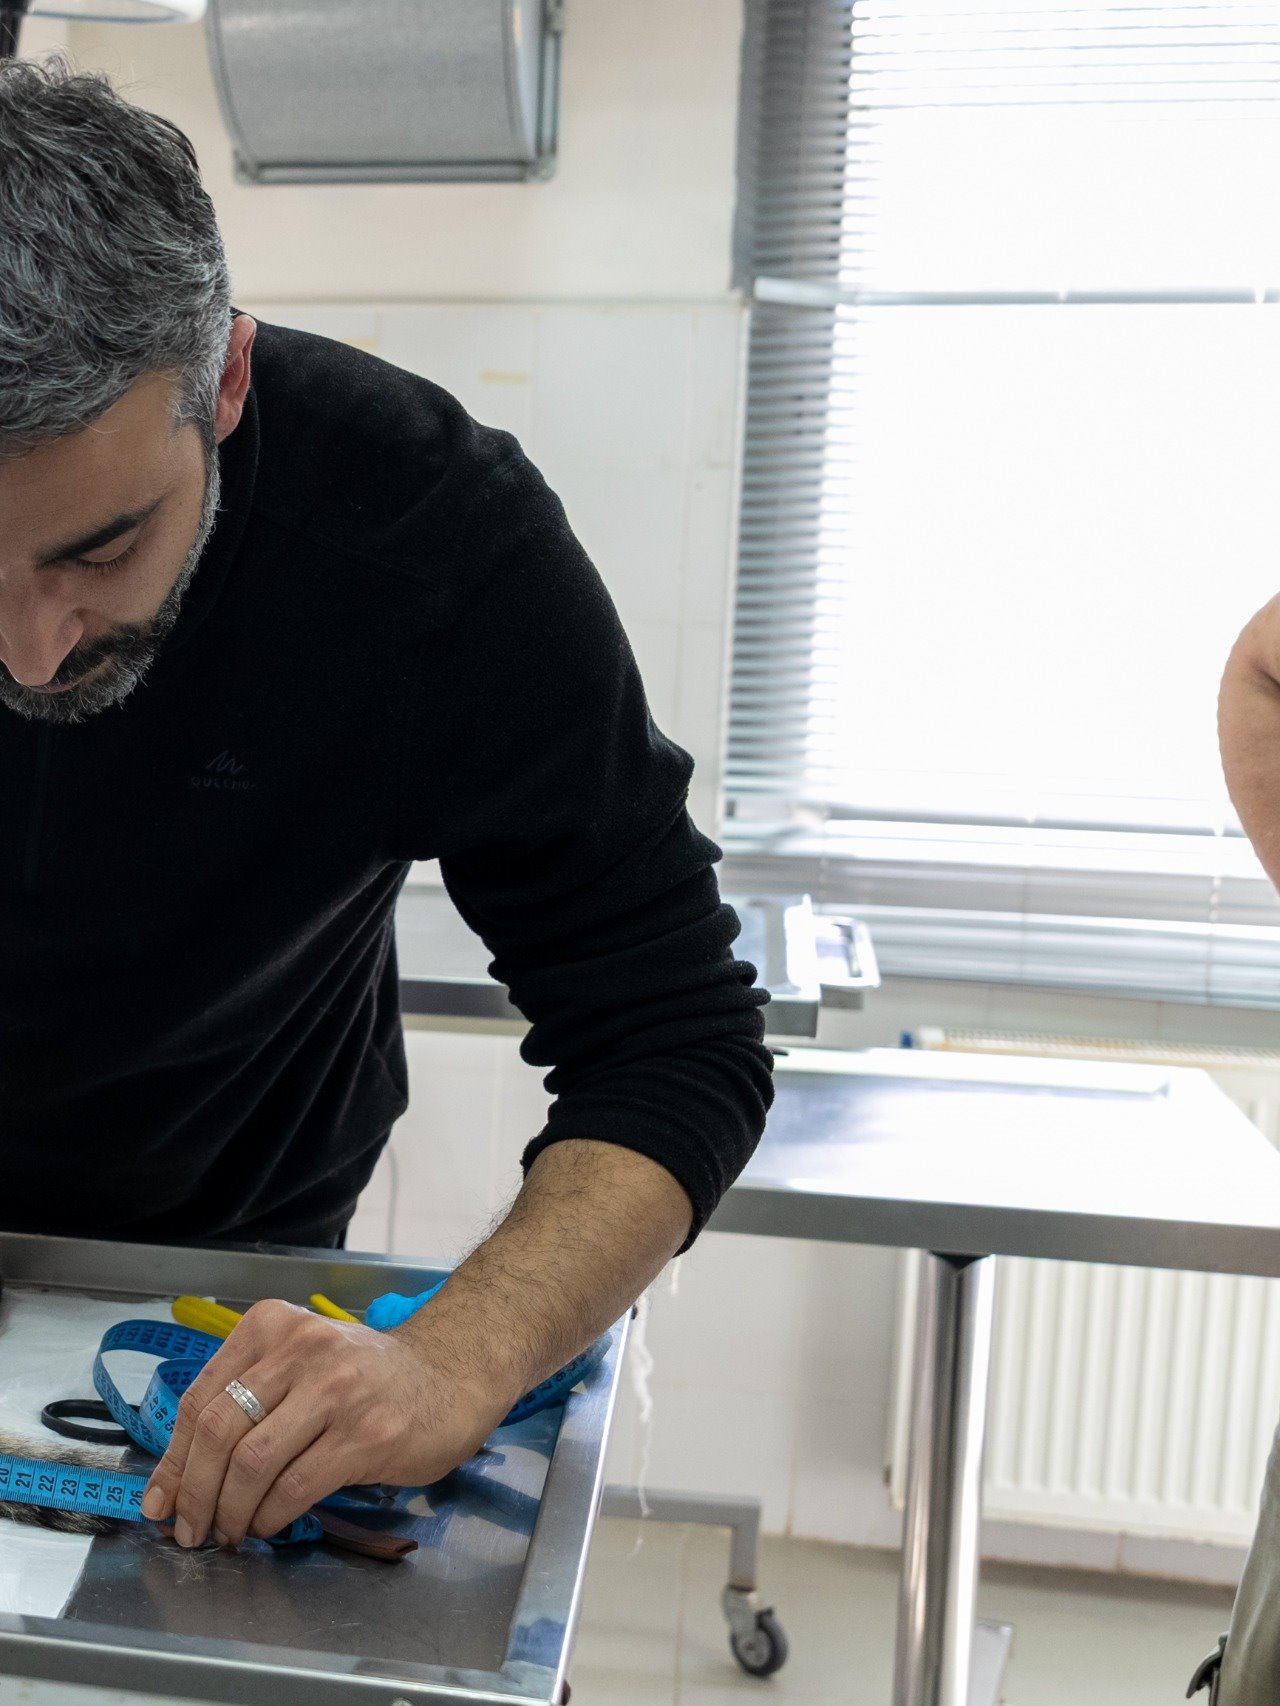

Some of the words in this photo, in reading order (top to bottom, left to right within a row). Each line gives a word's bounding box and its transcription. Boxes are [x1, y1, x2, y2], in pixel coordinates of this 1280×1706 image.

[155, 1406, 168, 1421] 46
[15, 1471, 32, 1488] 21
[37, 1475, 54, 1492] 22
[61, 1479, 78, 1496] 23
[83, 1482, 100, 1499] 24
[106, 1485, 123, 1503] 25
[129, 1489, 143, 1506] 26
